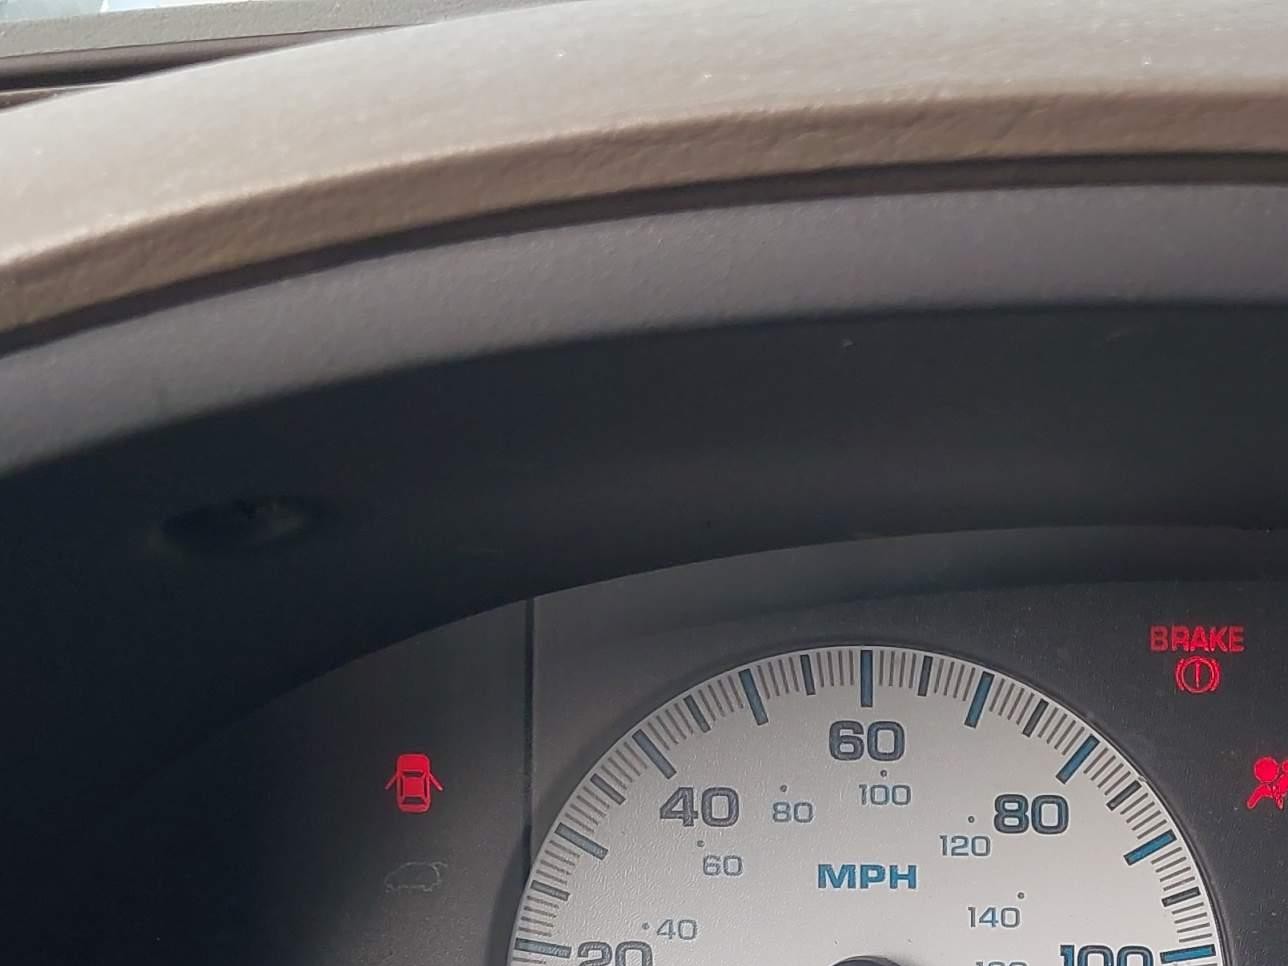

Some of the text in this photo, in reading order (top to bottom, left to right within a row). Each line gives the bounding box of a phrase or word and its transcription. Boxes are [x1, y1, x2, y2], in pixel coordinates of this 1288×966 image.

[1150, 626, 1244, 651] BRAKE
[828, 720, 905, 761] 60
[858, 783, 911, 806] 100
[659, 786, 740, 827] 40
[772, 802, 814, 823] 80
[993, 793, 1068, 834] 80
[939, 834, 991, 856] 120
[702, 855, 743, 876] 60
[817, 864, 917, 889] MPH
[967, 906, 1021, 928] 140
[656, 919, 698, 940] 40
